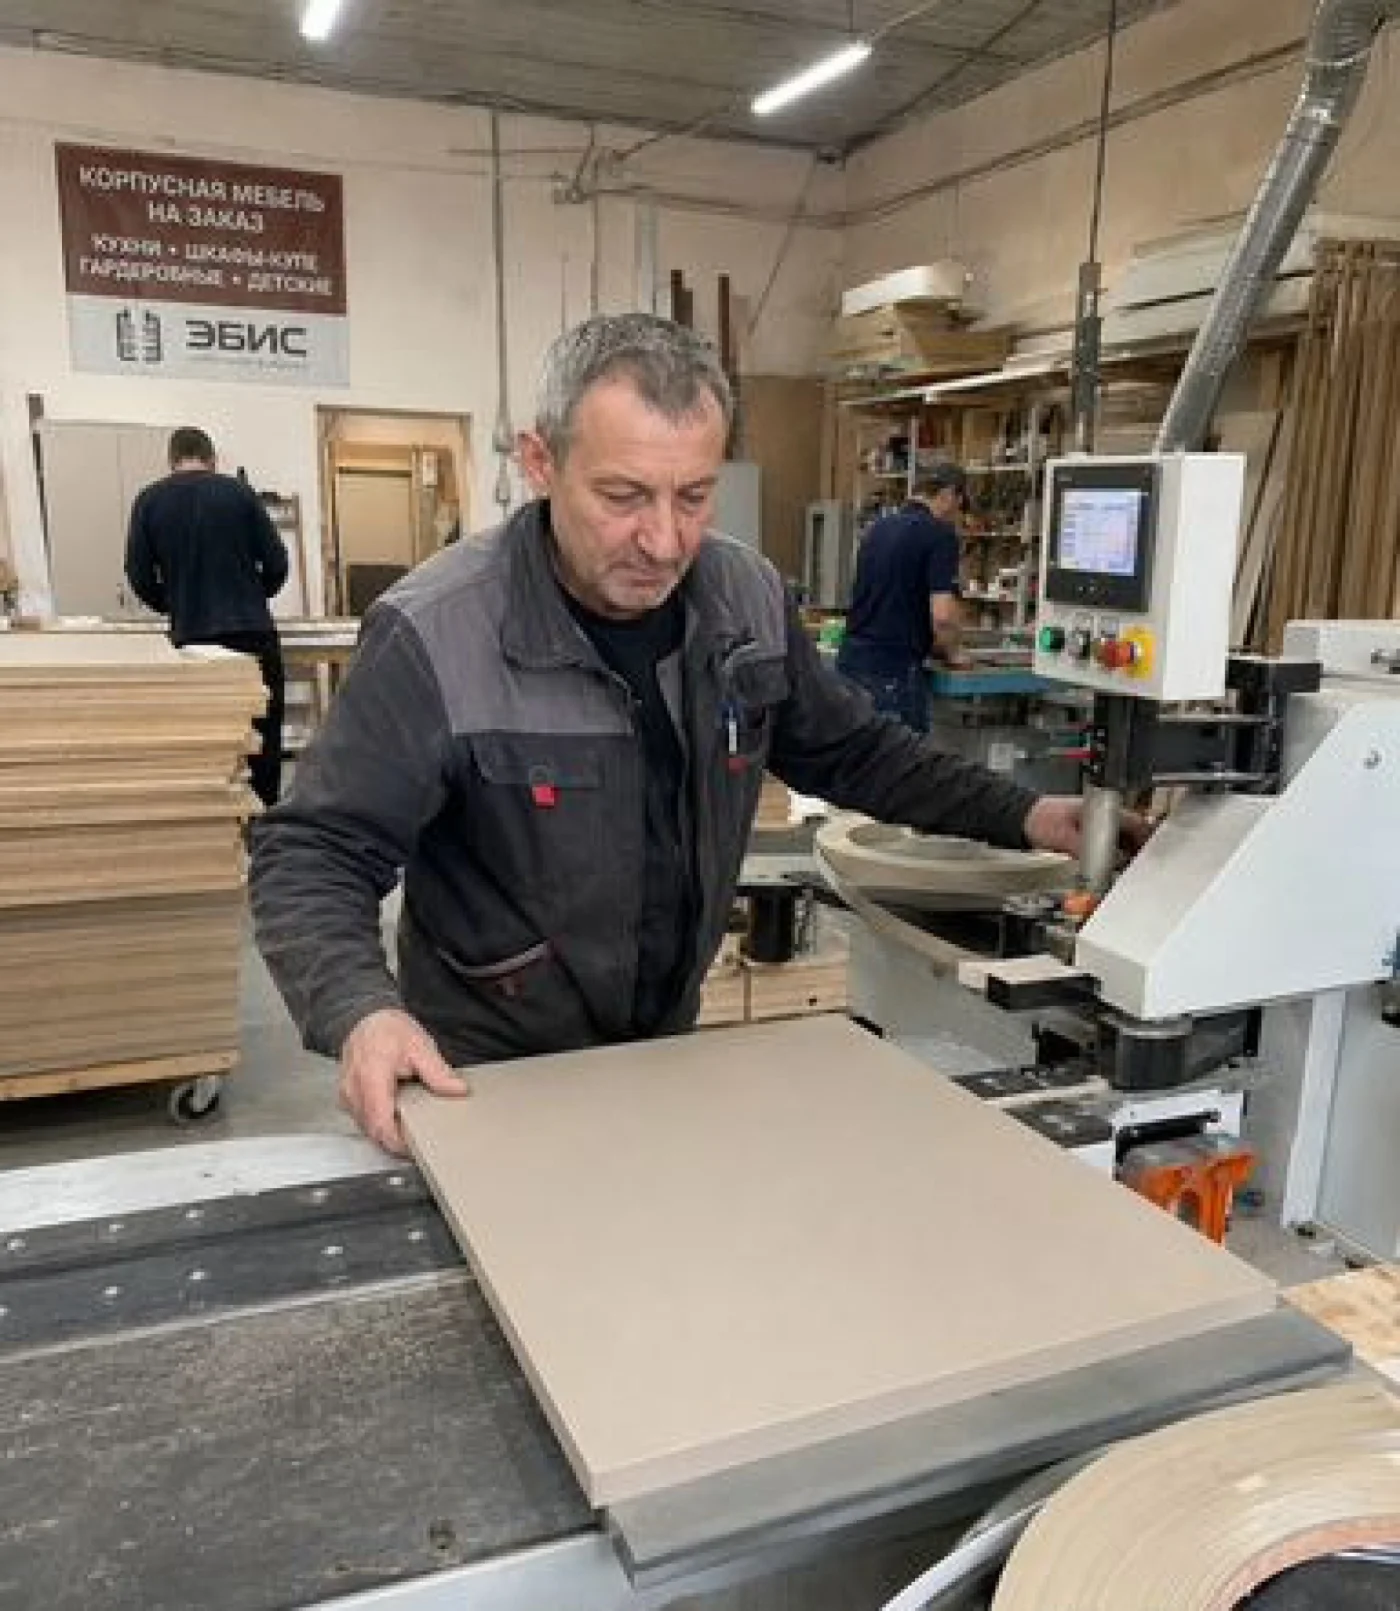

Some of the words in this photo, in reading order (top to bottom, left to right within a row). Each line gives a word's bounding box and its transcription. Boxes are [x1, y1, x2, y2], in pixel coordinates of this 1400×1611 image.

[79, 166, 227, 201] КОРПУСНАЯ
[232, 185, 326, 212] МЕБЕЛЬ
[148, 202, 181, 224] НА
[189, 206, 265, 233] ЗАКАЗ
[185, 319, 308, 358] ЭБИС
